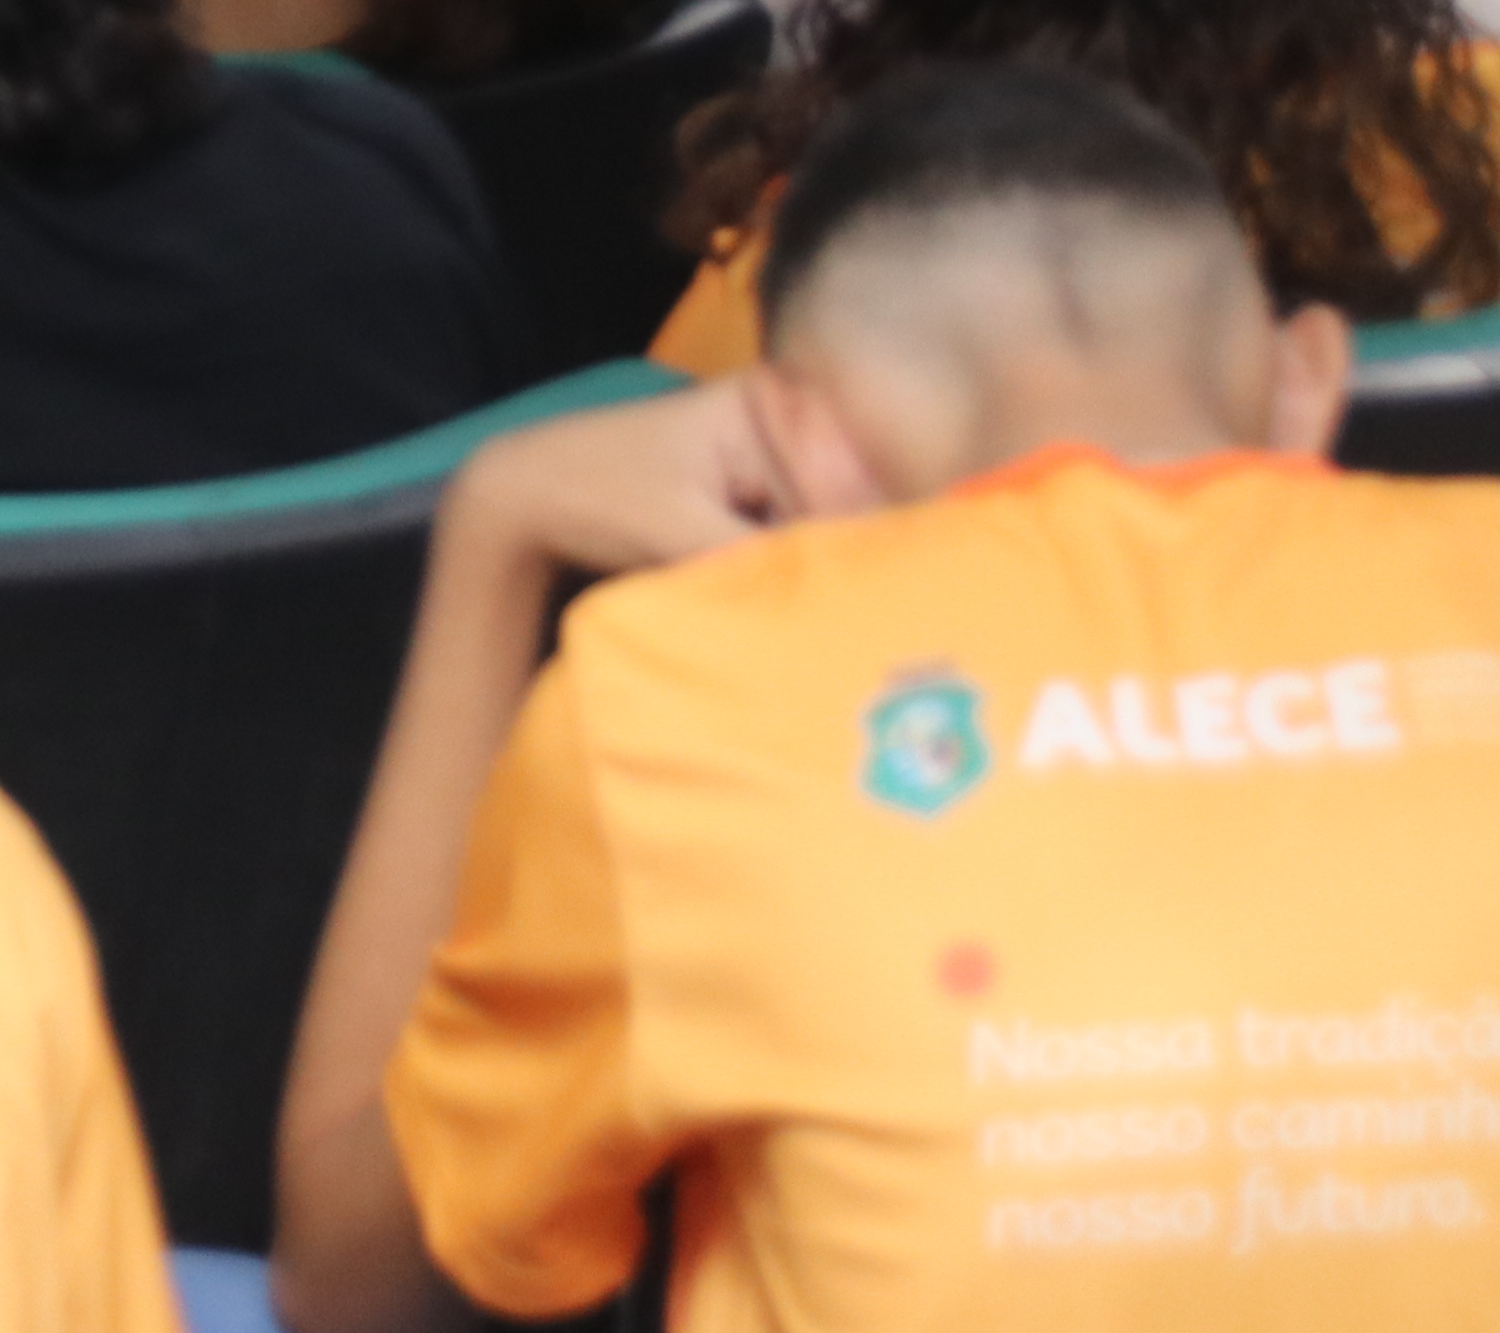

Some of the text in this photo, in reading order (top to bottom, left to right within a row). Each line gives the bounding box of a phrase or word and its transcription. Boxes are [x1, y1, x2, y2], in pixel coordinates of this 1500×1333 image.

[1019, 655, 1400, 771] ALECE
[968, 1014, 1214, 1085] Nossa
[979, 1104, 1210, 1169] nosso
[986, 1187, 1216, 1253] nosso
